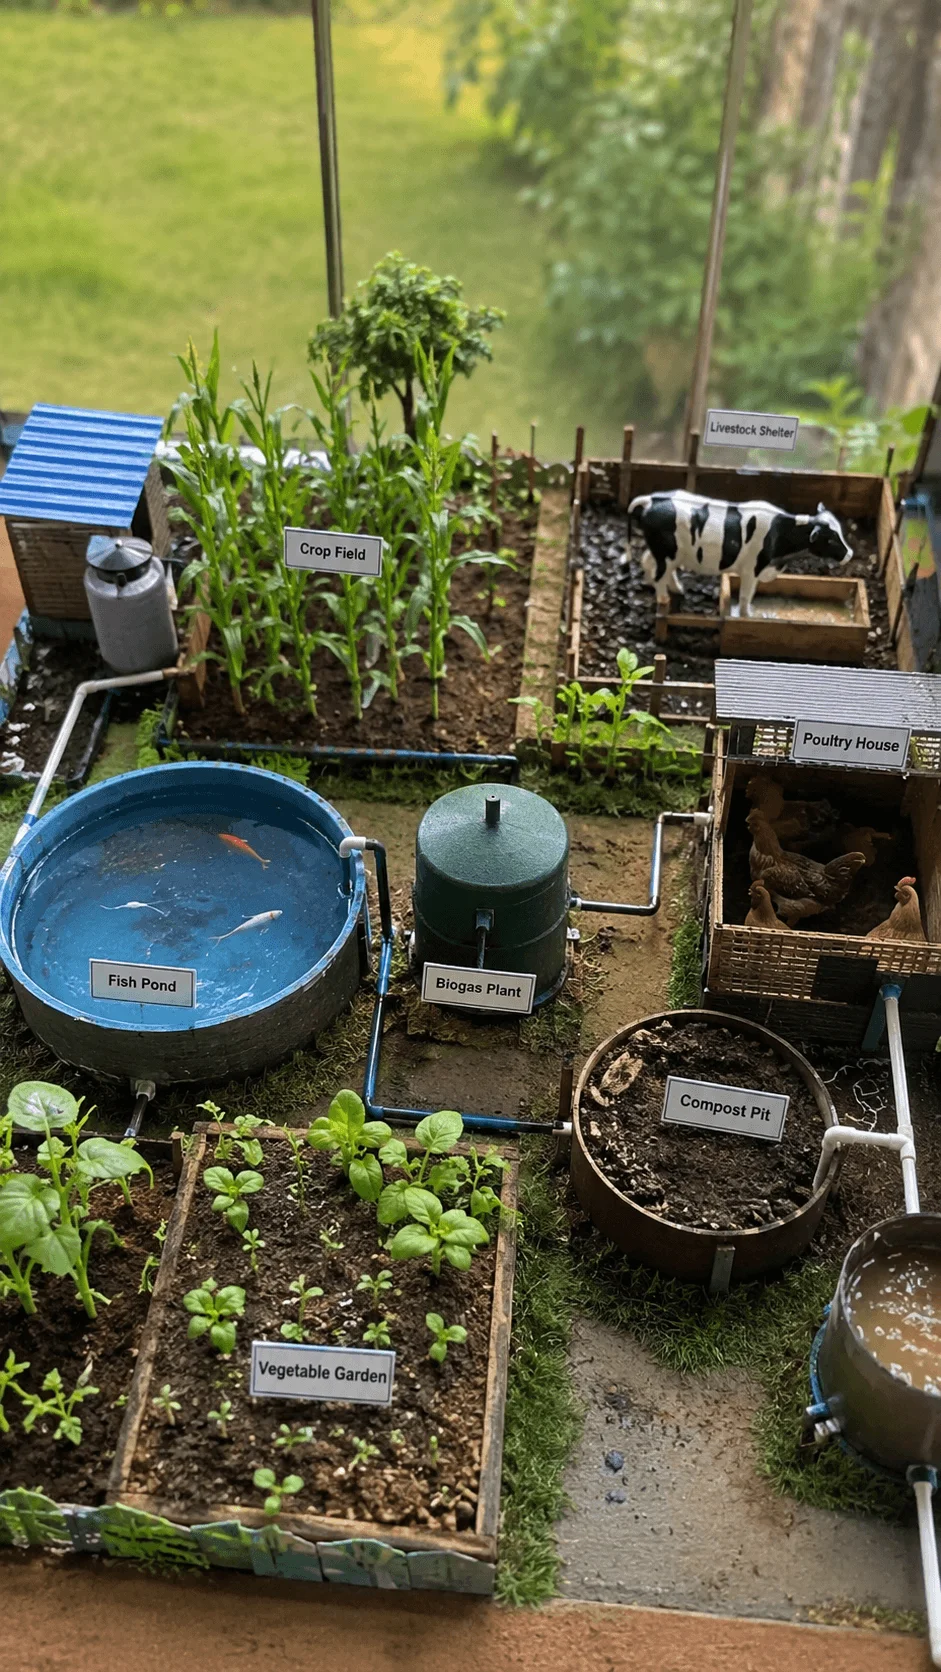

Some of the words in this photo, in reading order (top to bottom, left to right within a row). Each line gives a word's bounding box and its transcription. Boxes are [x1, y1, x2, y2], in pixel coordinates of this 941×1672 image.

[710, 421, 757, 435] Livestock
[759, 425, 795, 438] Shelter
[300, 542, 331, 560] Crop
[335, 546, 366, 561] Field
[803, 732, 852, 751] Poultry
[855, 736, 900, 752] House
[108, 974, 137, 988] Fish
[141, 977, 176, 992] Pond
[435, 977, 482, 994] Biogas
[486, 983, 522, 998] Plant
[680, 1094, 746, 1118] Compost
[750, 1106, 771, 1121] Pit
[258, 1361, 331, 1380] Vegetable
[334, 1366, 388, 1384] Garden
